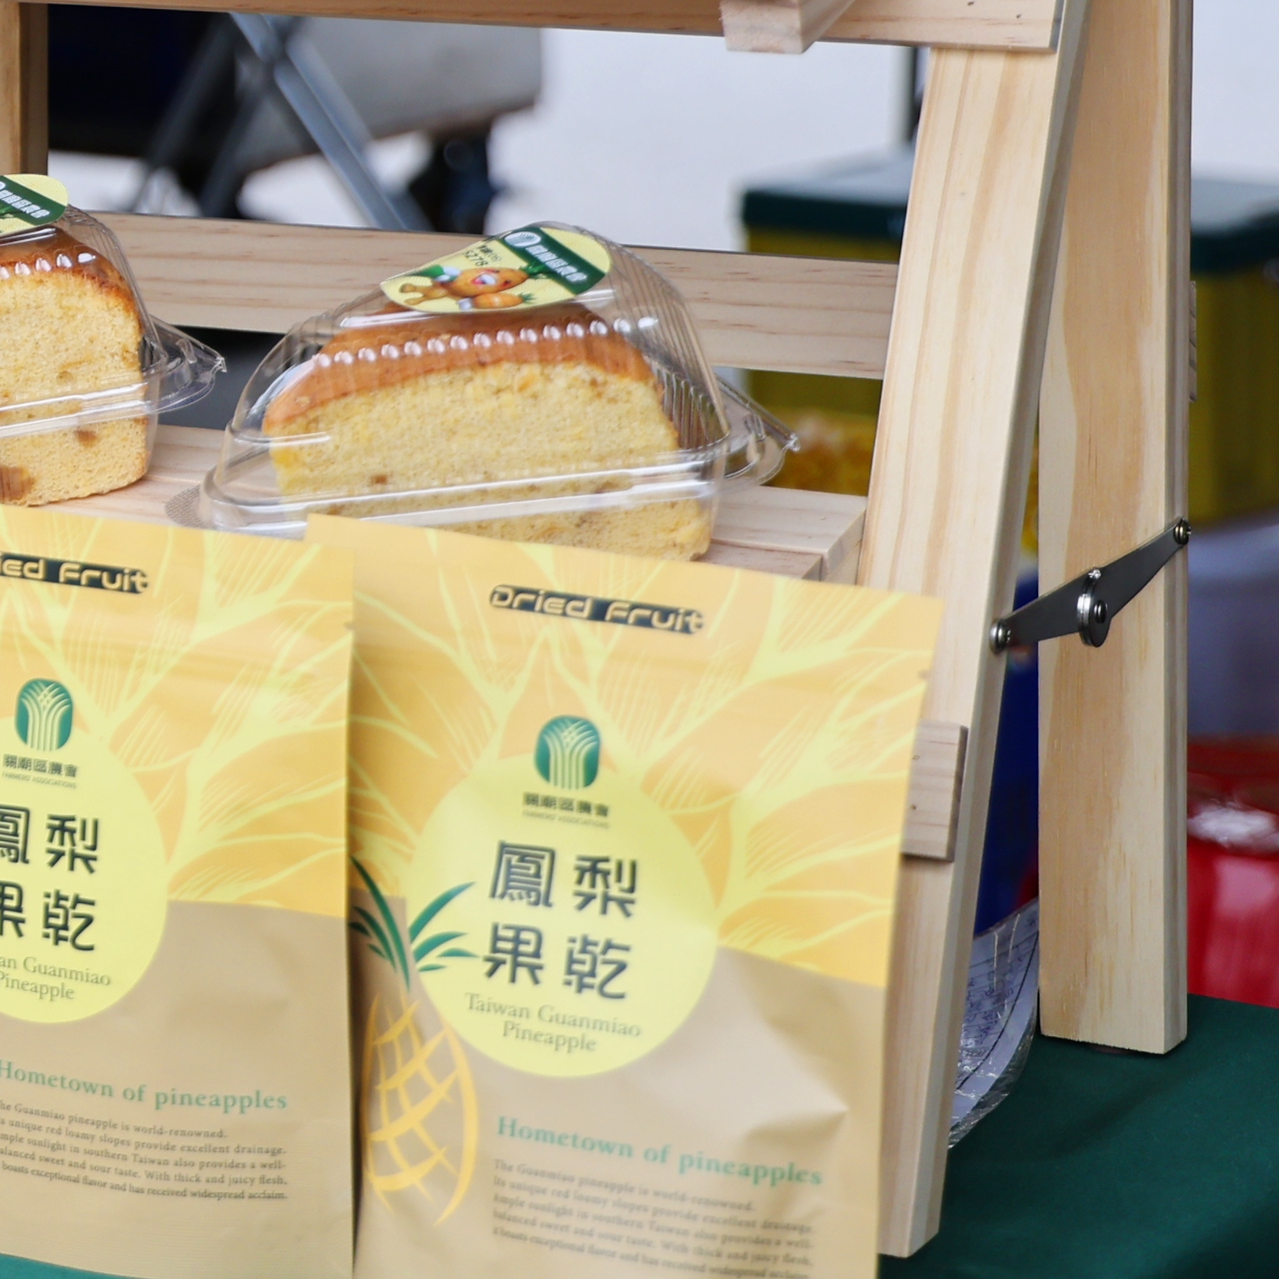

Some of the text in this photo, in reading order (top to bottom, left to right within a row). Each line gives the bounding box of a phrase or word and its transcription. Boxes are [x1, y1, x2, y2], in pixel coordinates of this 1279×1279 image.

[59, 562, 149, 594] Fruit
[491, 585, 705, 634] Dried Fruit
[489, 840, 638, 917] 鳳梨
[23, 955, 111, 987] Guanmiao
[482, 923, 633, 1000] 果乾
[465, 993, 641, 1038] Taiwan Guanmiao
[503, 1021, 597, 1053] Pineapple
[122, 1084, 147, 1102] of
[154, 1087, 288, 1114] pineapples
[497, 1116, 823, 1186] Hometown of pineapples
